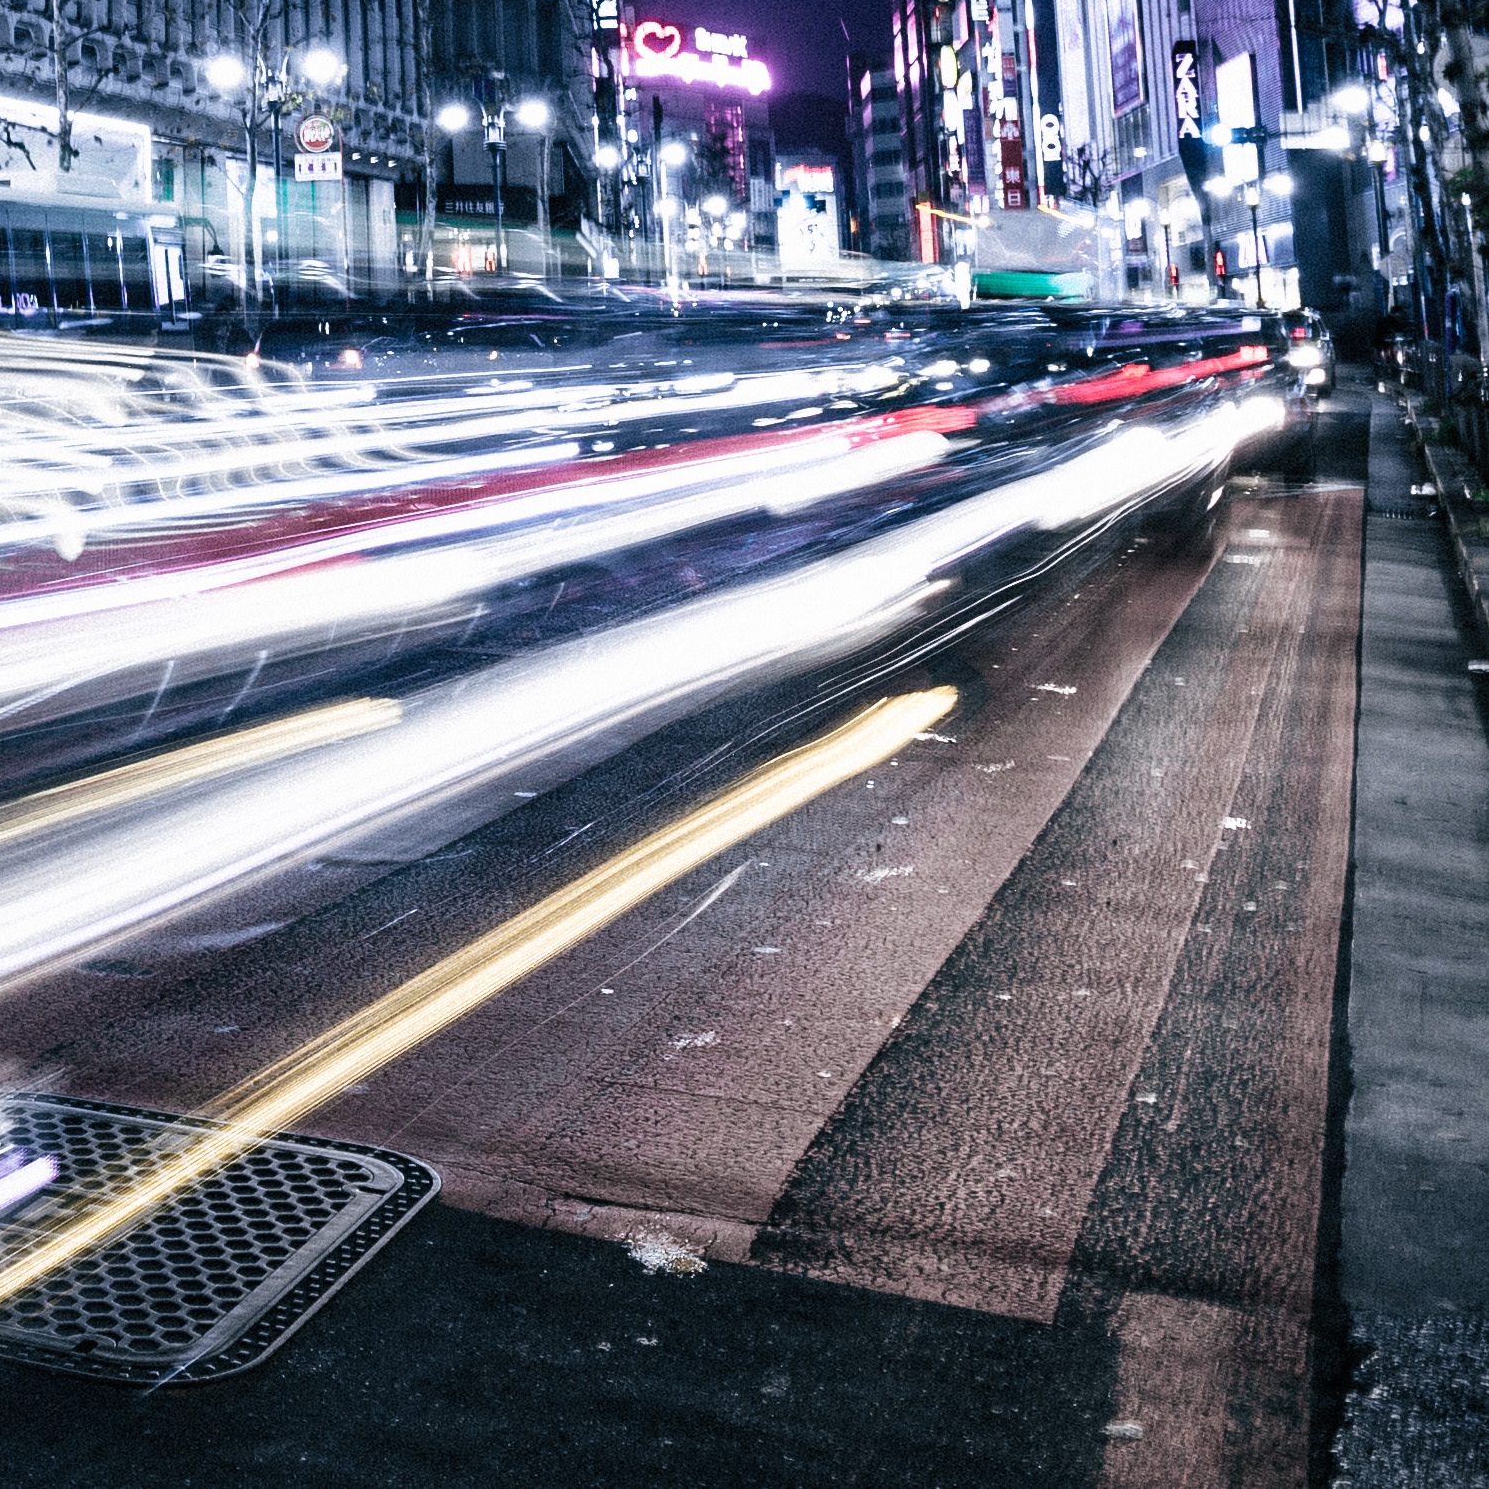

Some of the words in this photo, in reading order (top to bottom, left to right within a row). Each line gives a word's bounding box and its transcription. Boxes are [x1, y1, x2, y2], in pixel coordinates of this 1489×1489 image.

[1176, 53, 1201, 139] ZARA
[445, 200, 505, 215] 三井住友銀行
